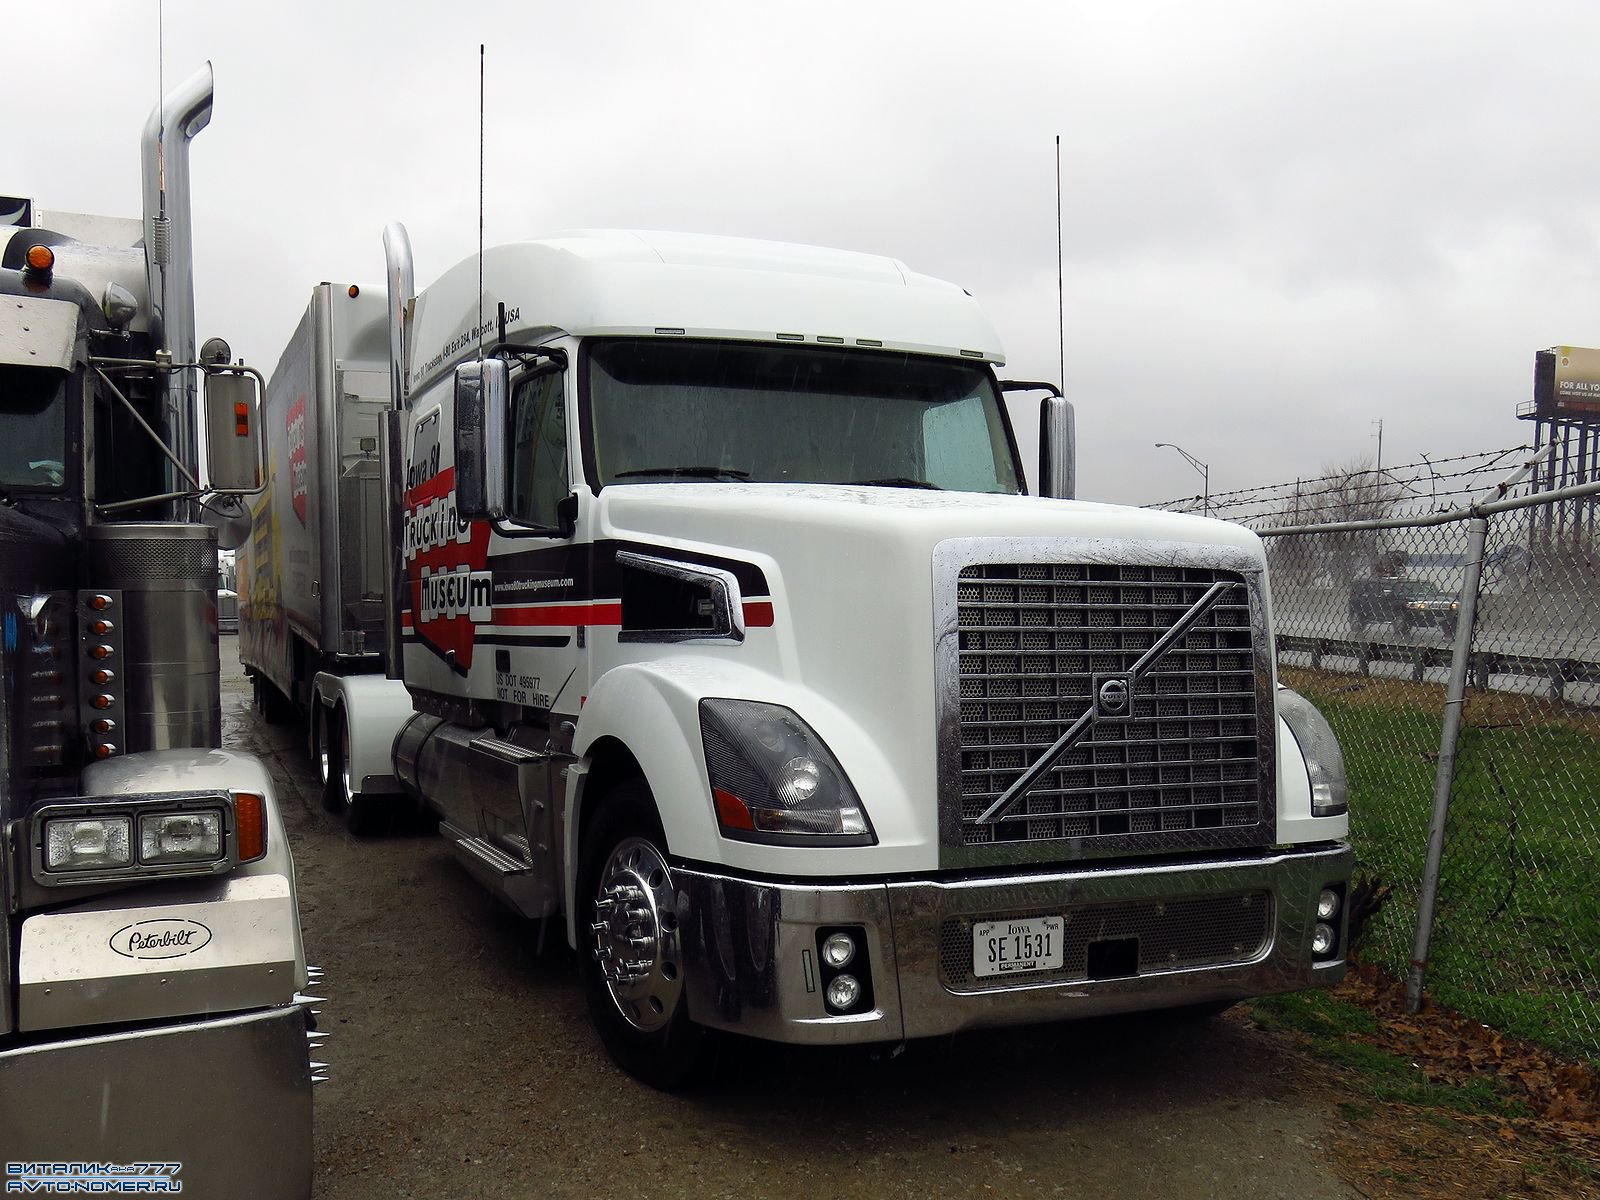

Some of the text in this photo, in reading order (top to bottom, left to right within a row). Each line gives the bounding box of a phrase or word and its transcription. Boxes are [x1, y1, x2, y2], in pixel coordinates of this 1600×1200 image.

[451, 338, 460, 354] Exit
[471, 319, 494, 341] Wacott,
[504, 307, 520, 325] USA
[1560, 381, 1574, 390] FOR
[1575, 382, 1588, 391] ALL
[405, 459, 426, 491] Iowa
[505, 674, 517, 687] DOT
[513, 690, 527, 703] FOR
[532, 692, 550, 708] HIRE
[128, 929, 197, 952] Peterbilt
[988, 932, 1052, 962] SE 1531
